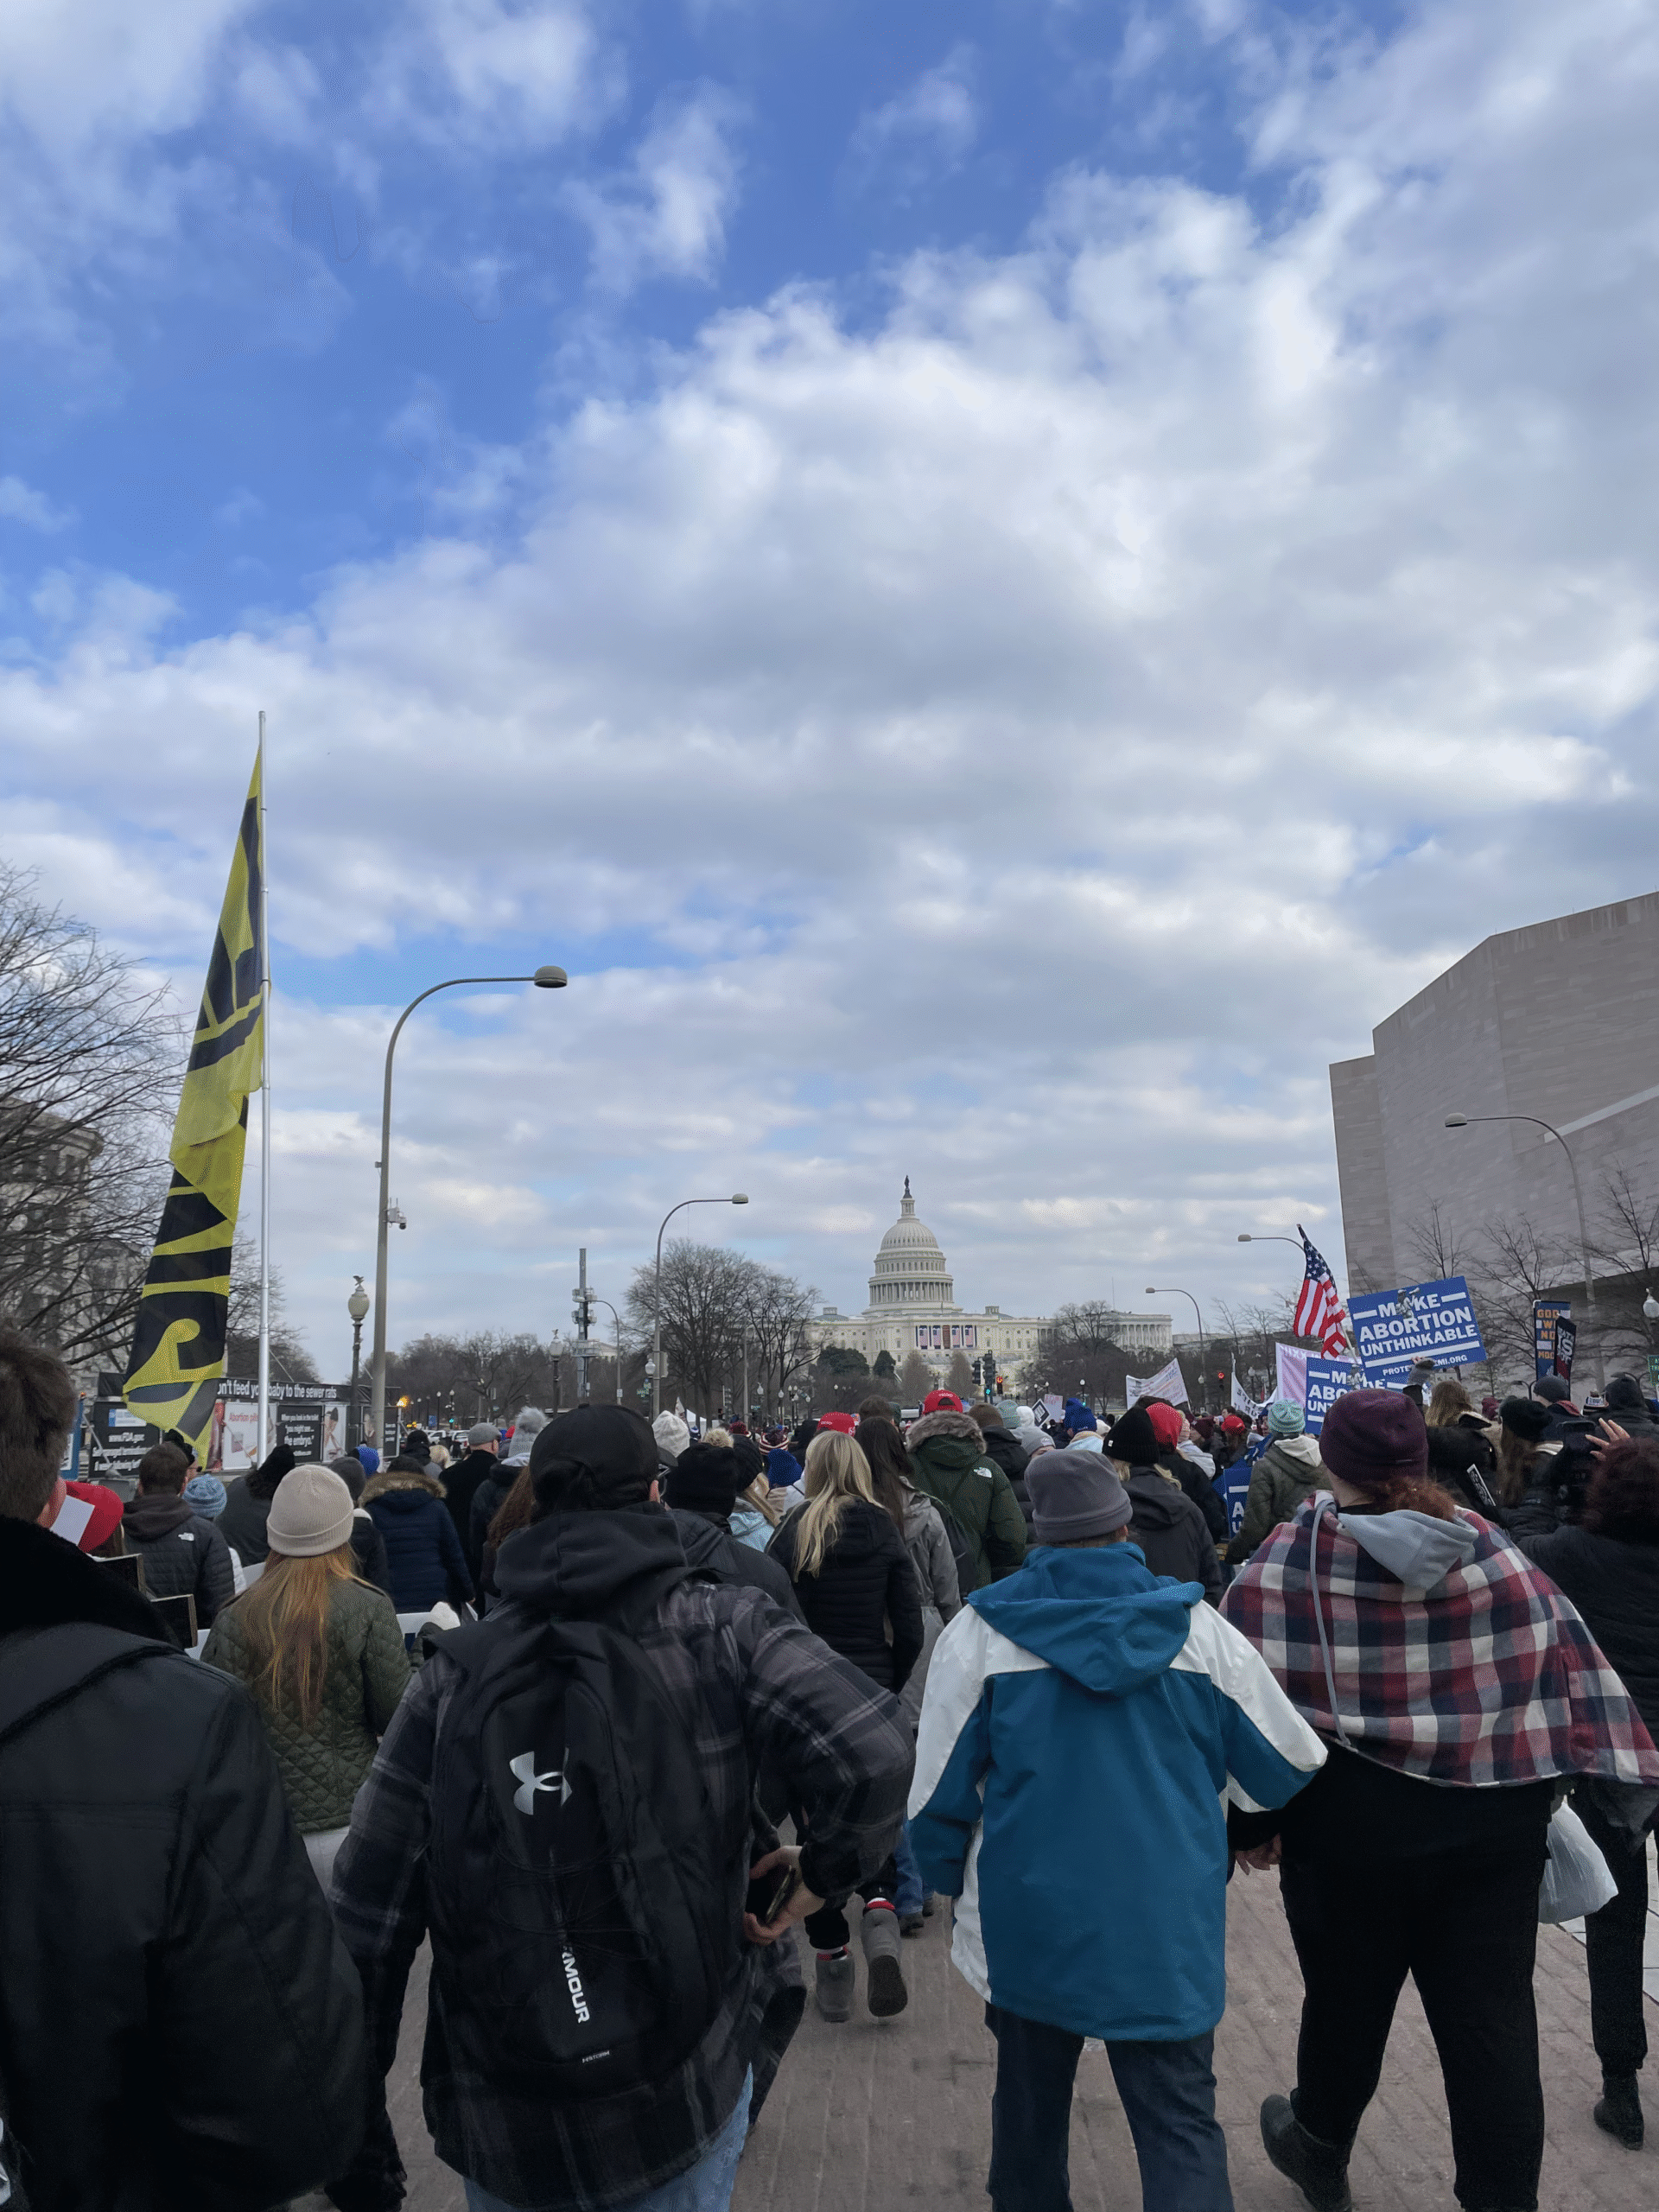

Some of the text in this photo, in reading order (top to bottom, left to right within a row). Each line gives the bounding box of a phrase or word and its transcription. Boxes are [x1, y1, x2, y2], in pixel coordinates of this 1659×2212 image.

[1378, 1294, 1440, 1318] MKE
[1359, 1306, 1471, 1342] ABORTION
[1360, 1325, 1477, 1356] UNTHINKABLE
[233, 1380, 250, 1395] feed
[268, 1382, 285, 1400] baby
[286, 1383, 293, 1397] to
[294, 1383, 305, 1397] the
[306, 1387, 324, 1398] sewer
[325, 1386, 337, 1399] rats
